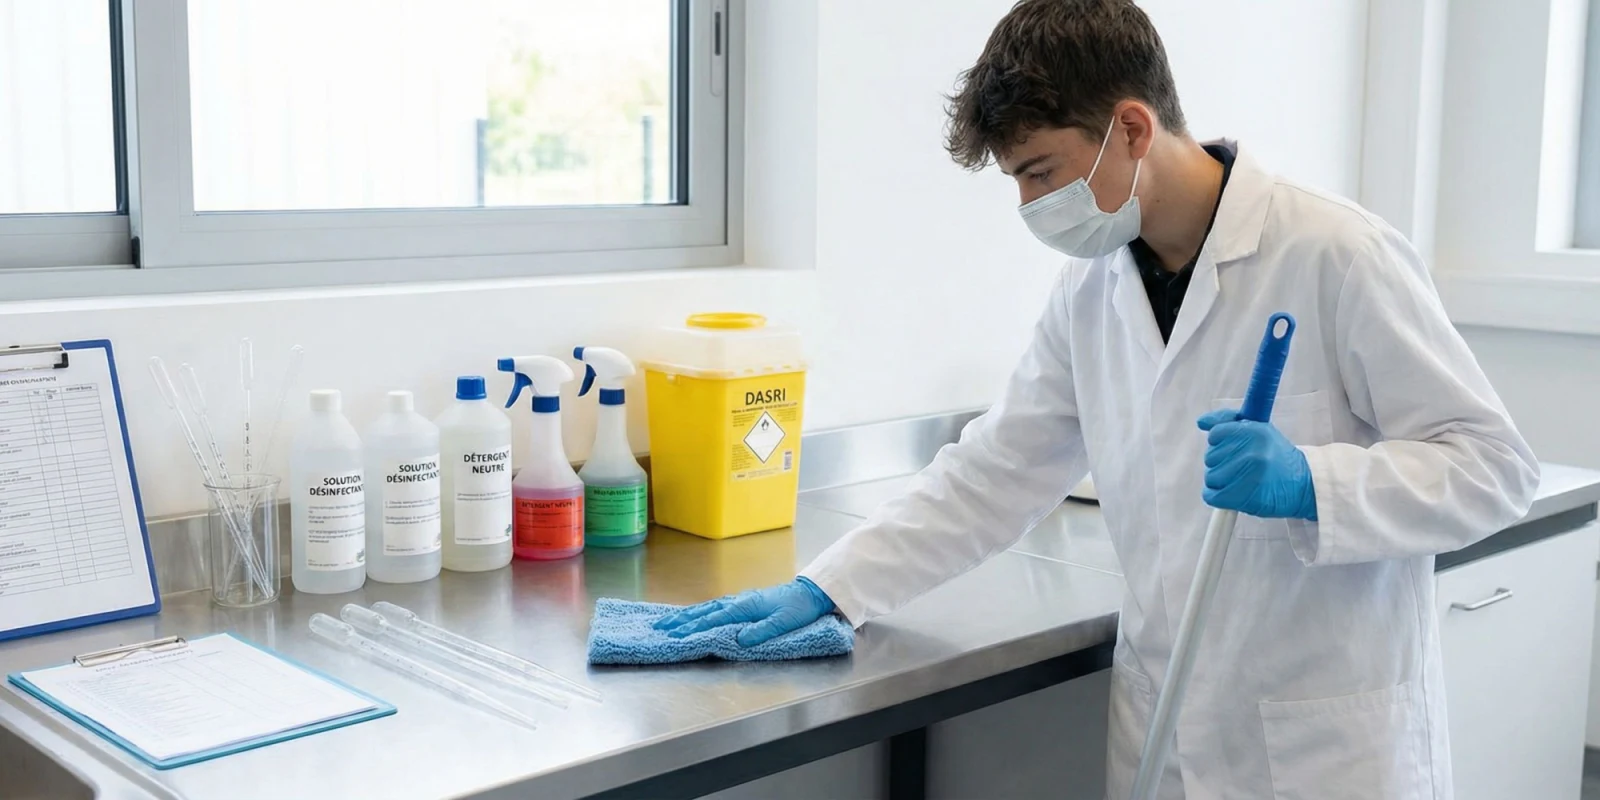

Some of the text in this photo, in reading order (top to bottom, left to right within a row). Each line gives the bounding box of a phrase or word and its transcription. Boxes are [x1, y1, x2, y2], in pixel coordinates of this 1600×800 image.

[745, 388, 786, 406] DASRI
[398, 461, 437, 473] SOLUTION
[472, 463, 505, 474] NEUTRE
[323, 474, 361, 486] SOLUTION
